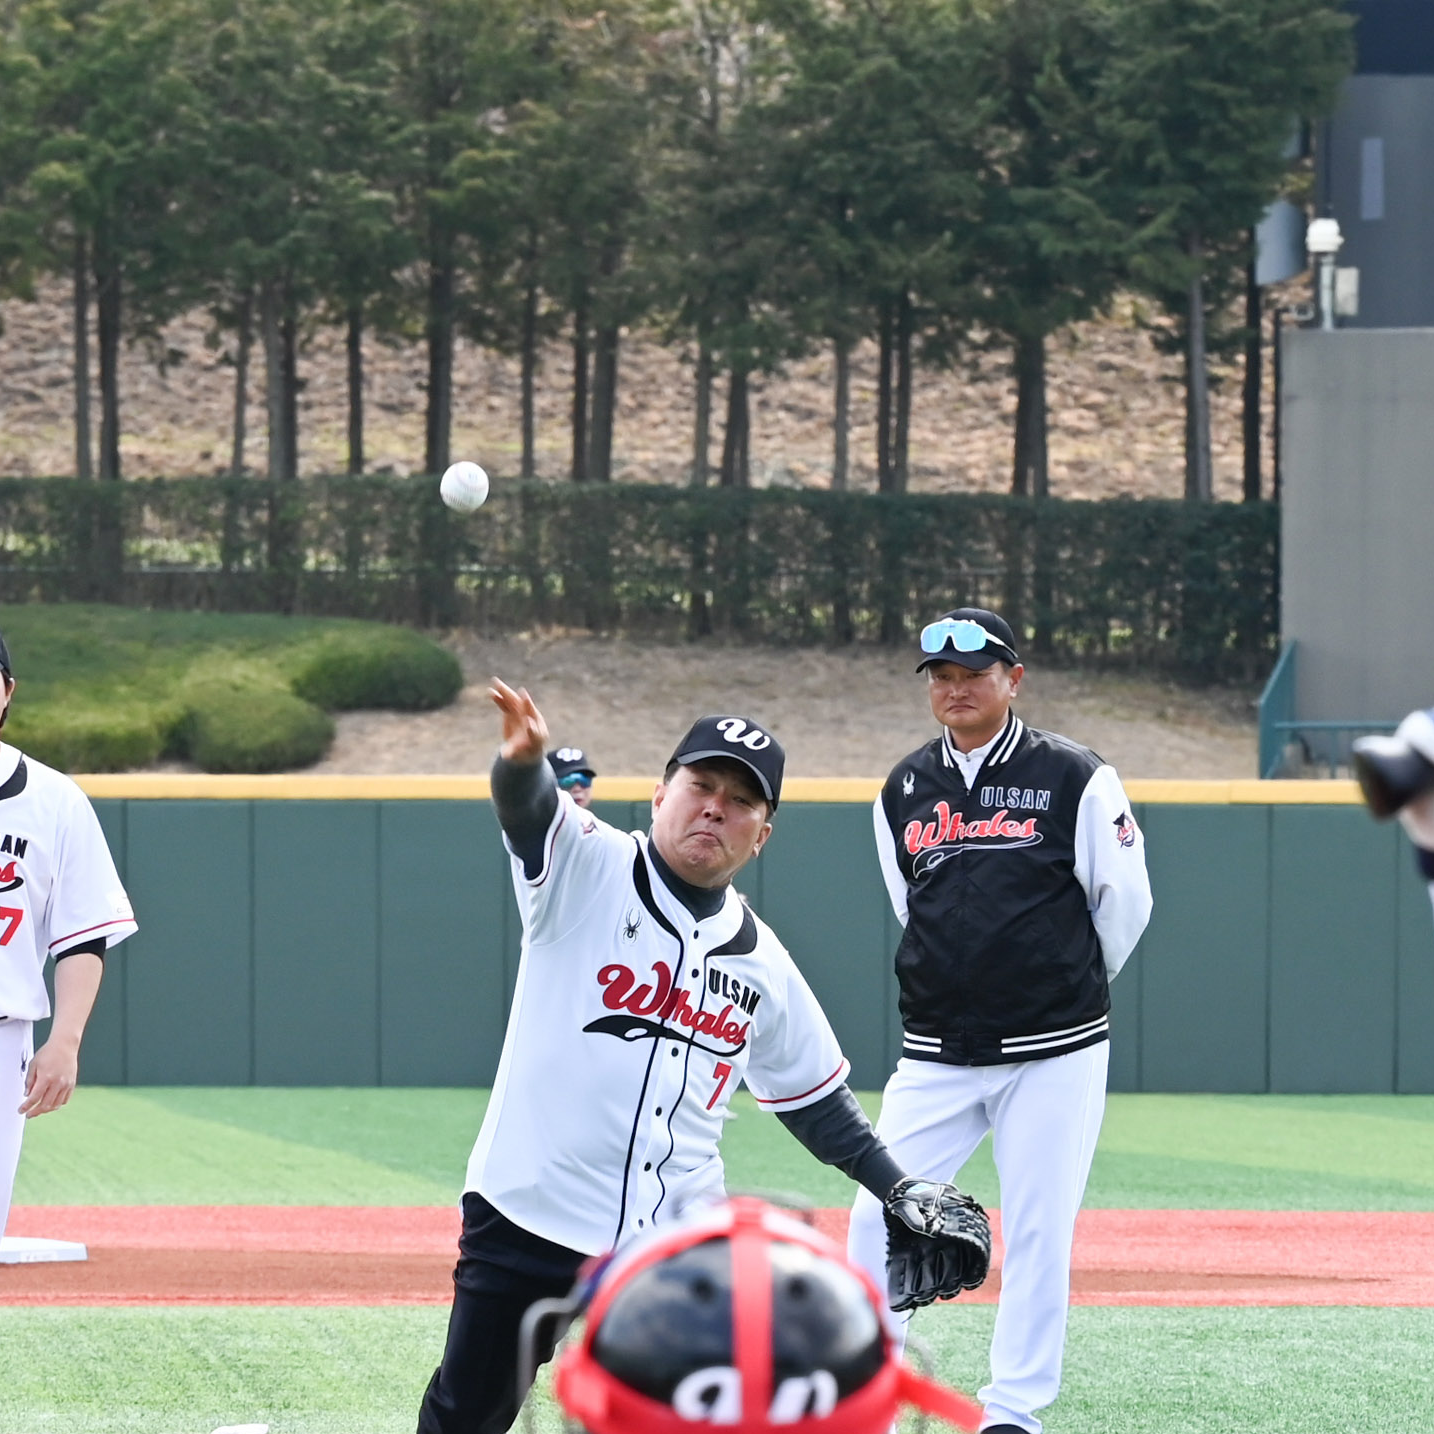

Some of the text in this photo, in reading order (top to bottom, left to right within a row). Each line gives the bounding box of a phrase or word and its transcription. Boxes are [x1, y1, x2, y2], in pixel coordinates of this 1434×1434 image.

[716, 718, 771, 751] W
[980, 786, 1051, 811] ULSAN
[904, 801, 1038, 855] Whales
[597, 961, 750, 1045] Whales
[709, 967, 761, 1016] ULSAN
[706, 1061, 732, 1110] 7
